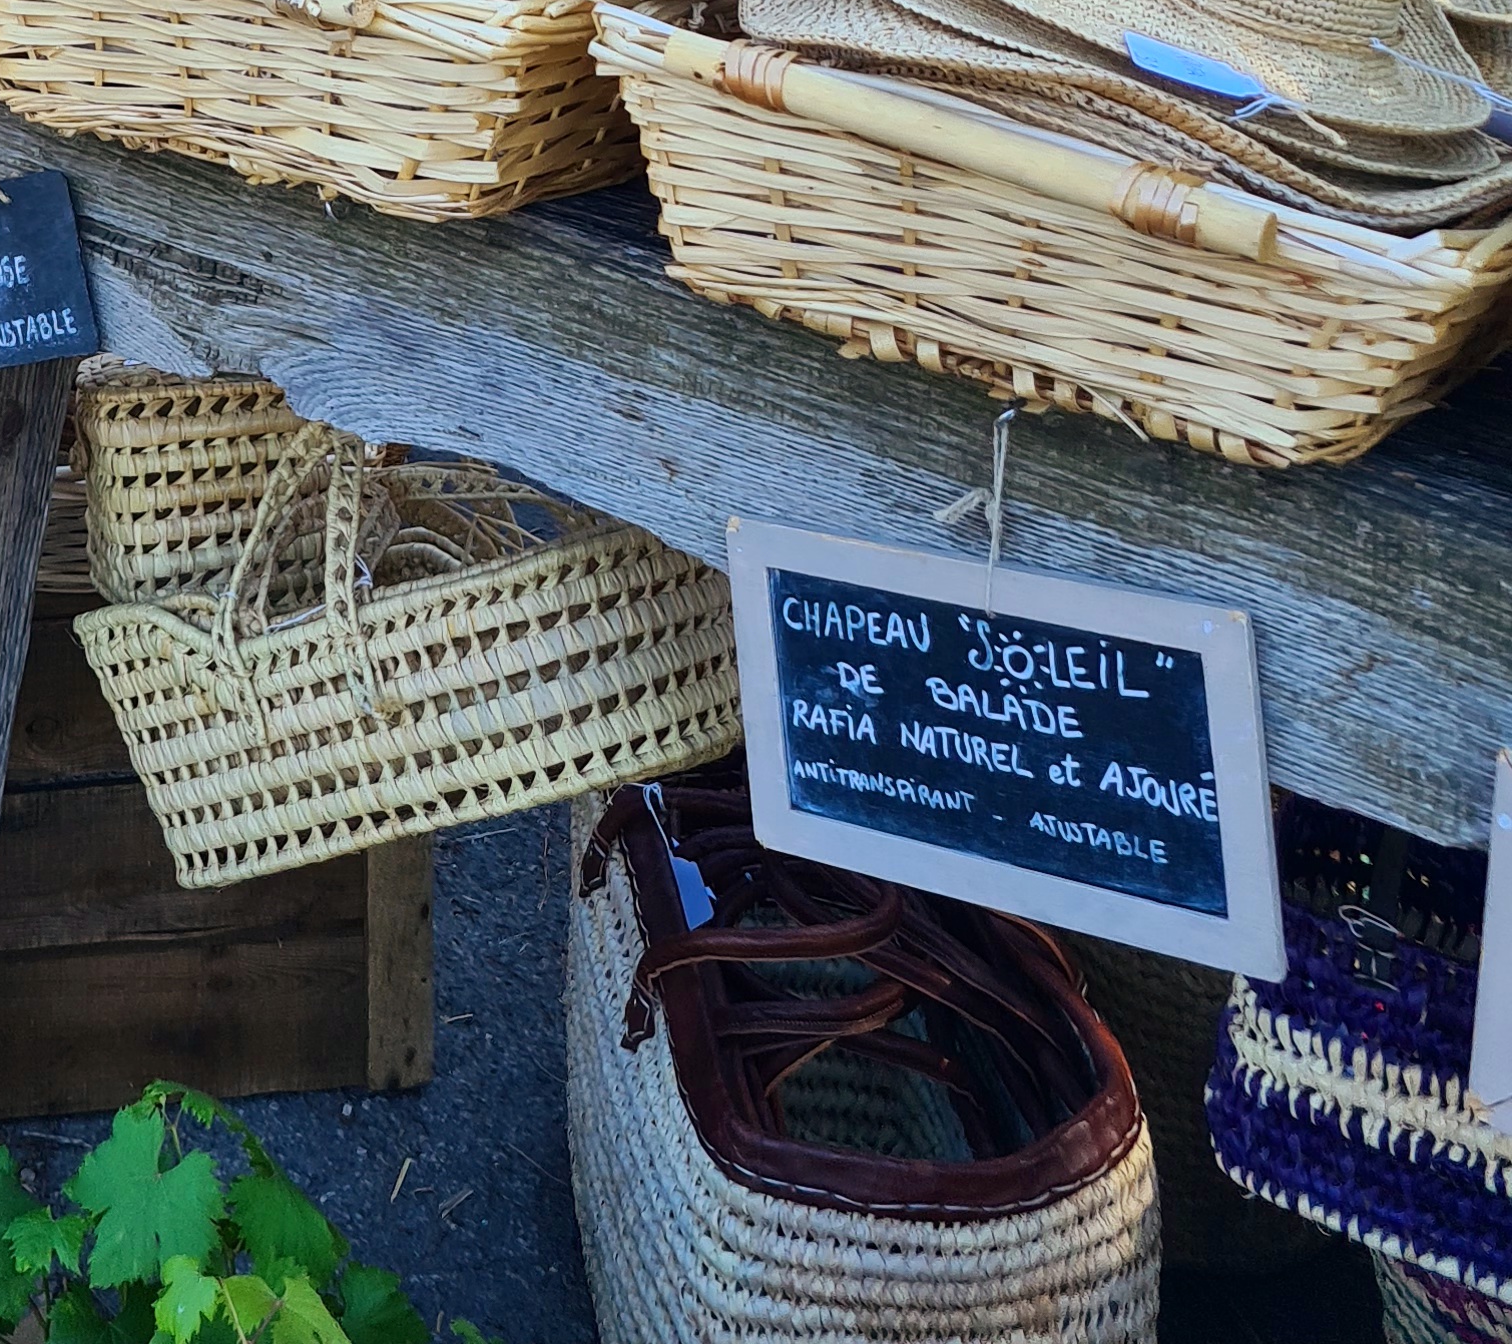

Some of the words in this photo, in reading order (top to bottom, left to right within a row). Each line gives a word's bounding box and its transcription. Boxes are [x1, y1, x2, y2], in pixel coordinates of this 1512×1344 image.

[783, 596, 931, 654] CHAPEAU
[838, 661, 885, 695] DE
[926, 676, 1084, 739] BALADE
[900, 721, 1034, 779] NATUREL
[1048, 753, 1081, 788] et
[1099, 761, 1219, 823] AJOURÉ
[1029, 811, 1170, 865] AJUSTABLE
